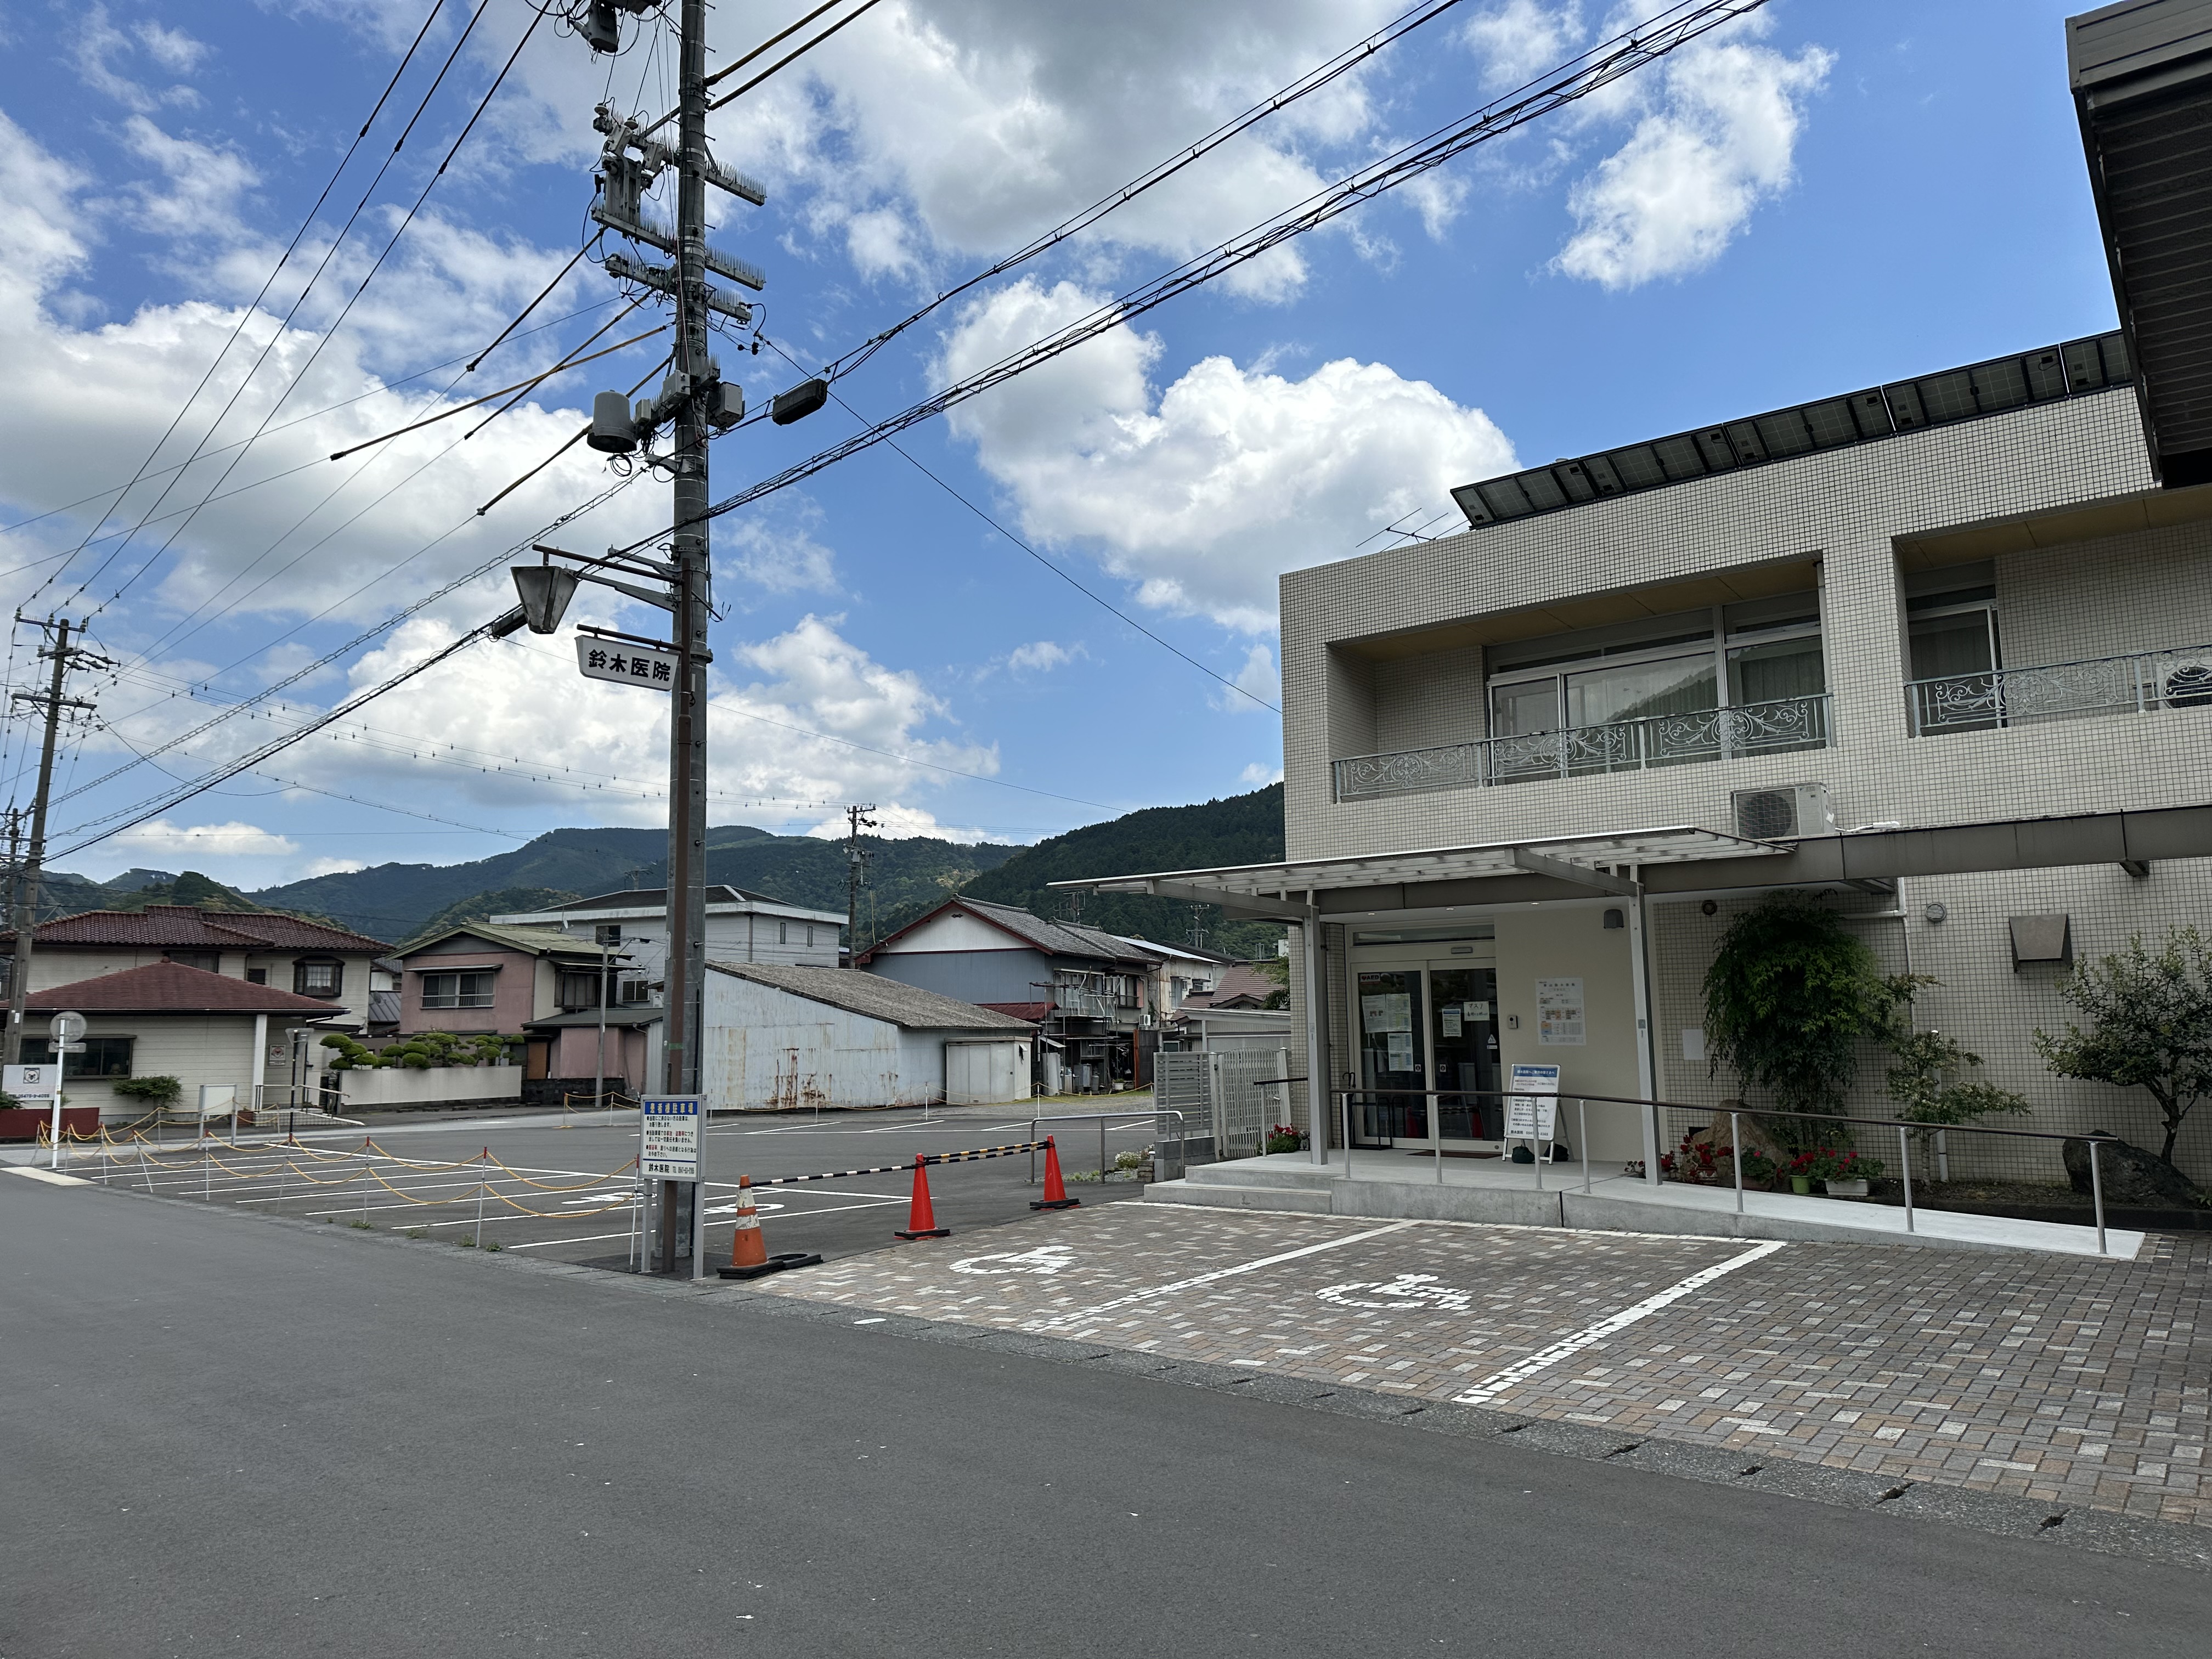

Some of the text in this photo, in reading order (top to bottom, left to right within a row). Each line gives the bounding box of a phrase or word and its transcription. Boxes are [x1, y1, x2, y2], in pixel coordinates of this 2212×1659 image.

[589, 649, 671, 681] 鈴木医院
[648, 1163, 669, 1173] 鈴木医院
